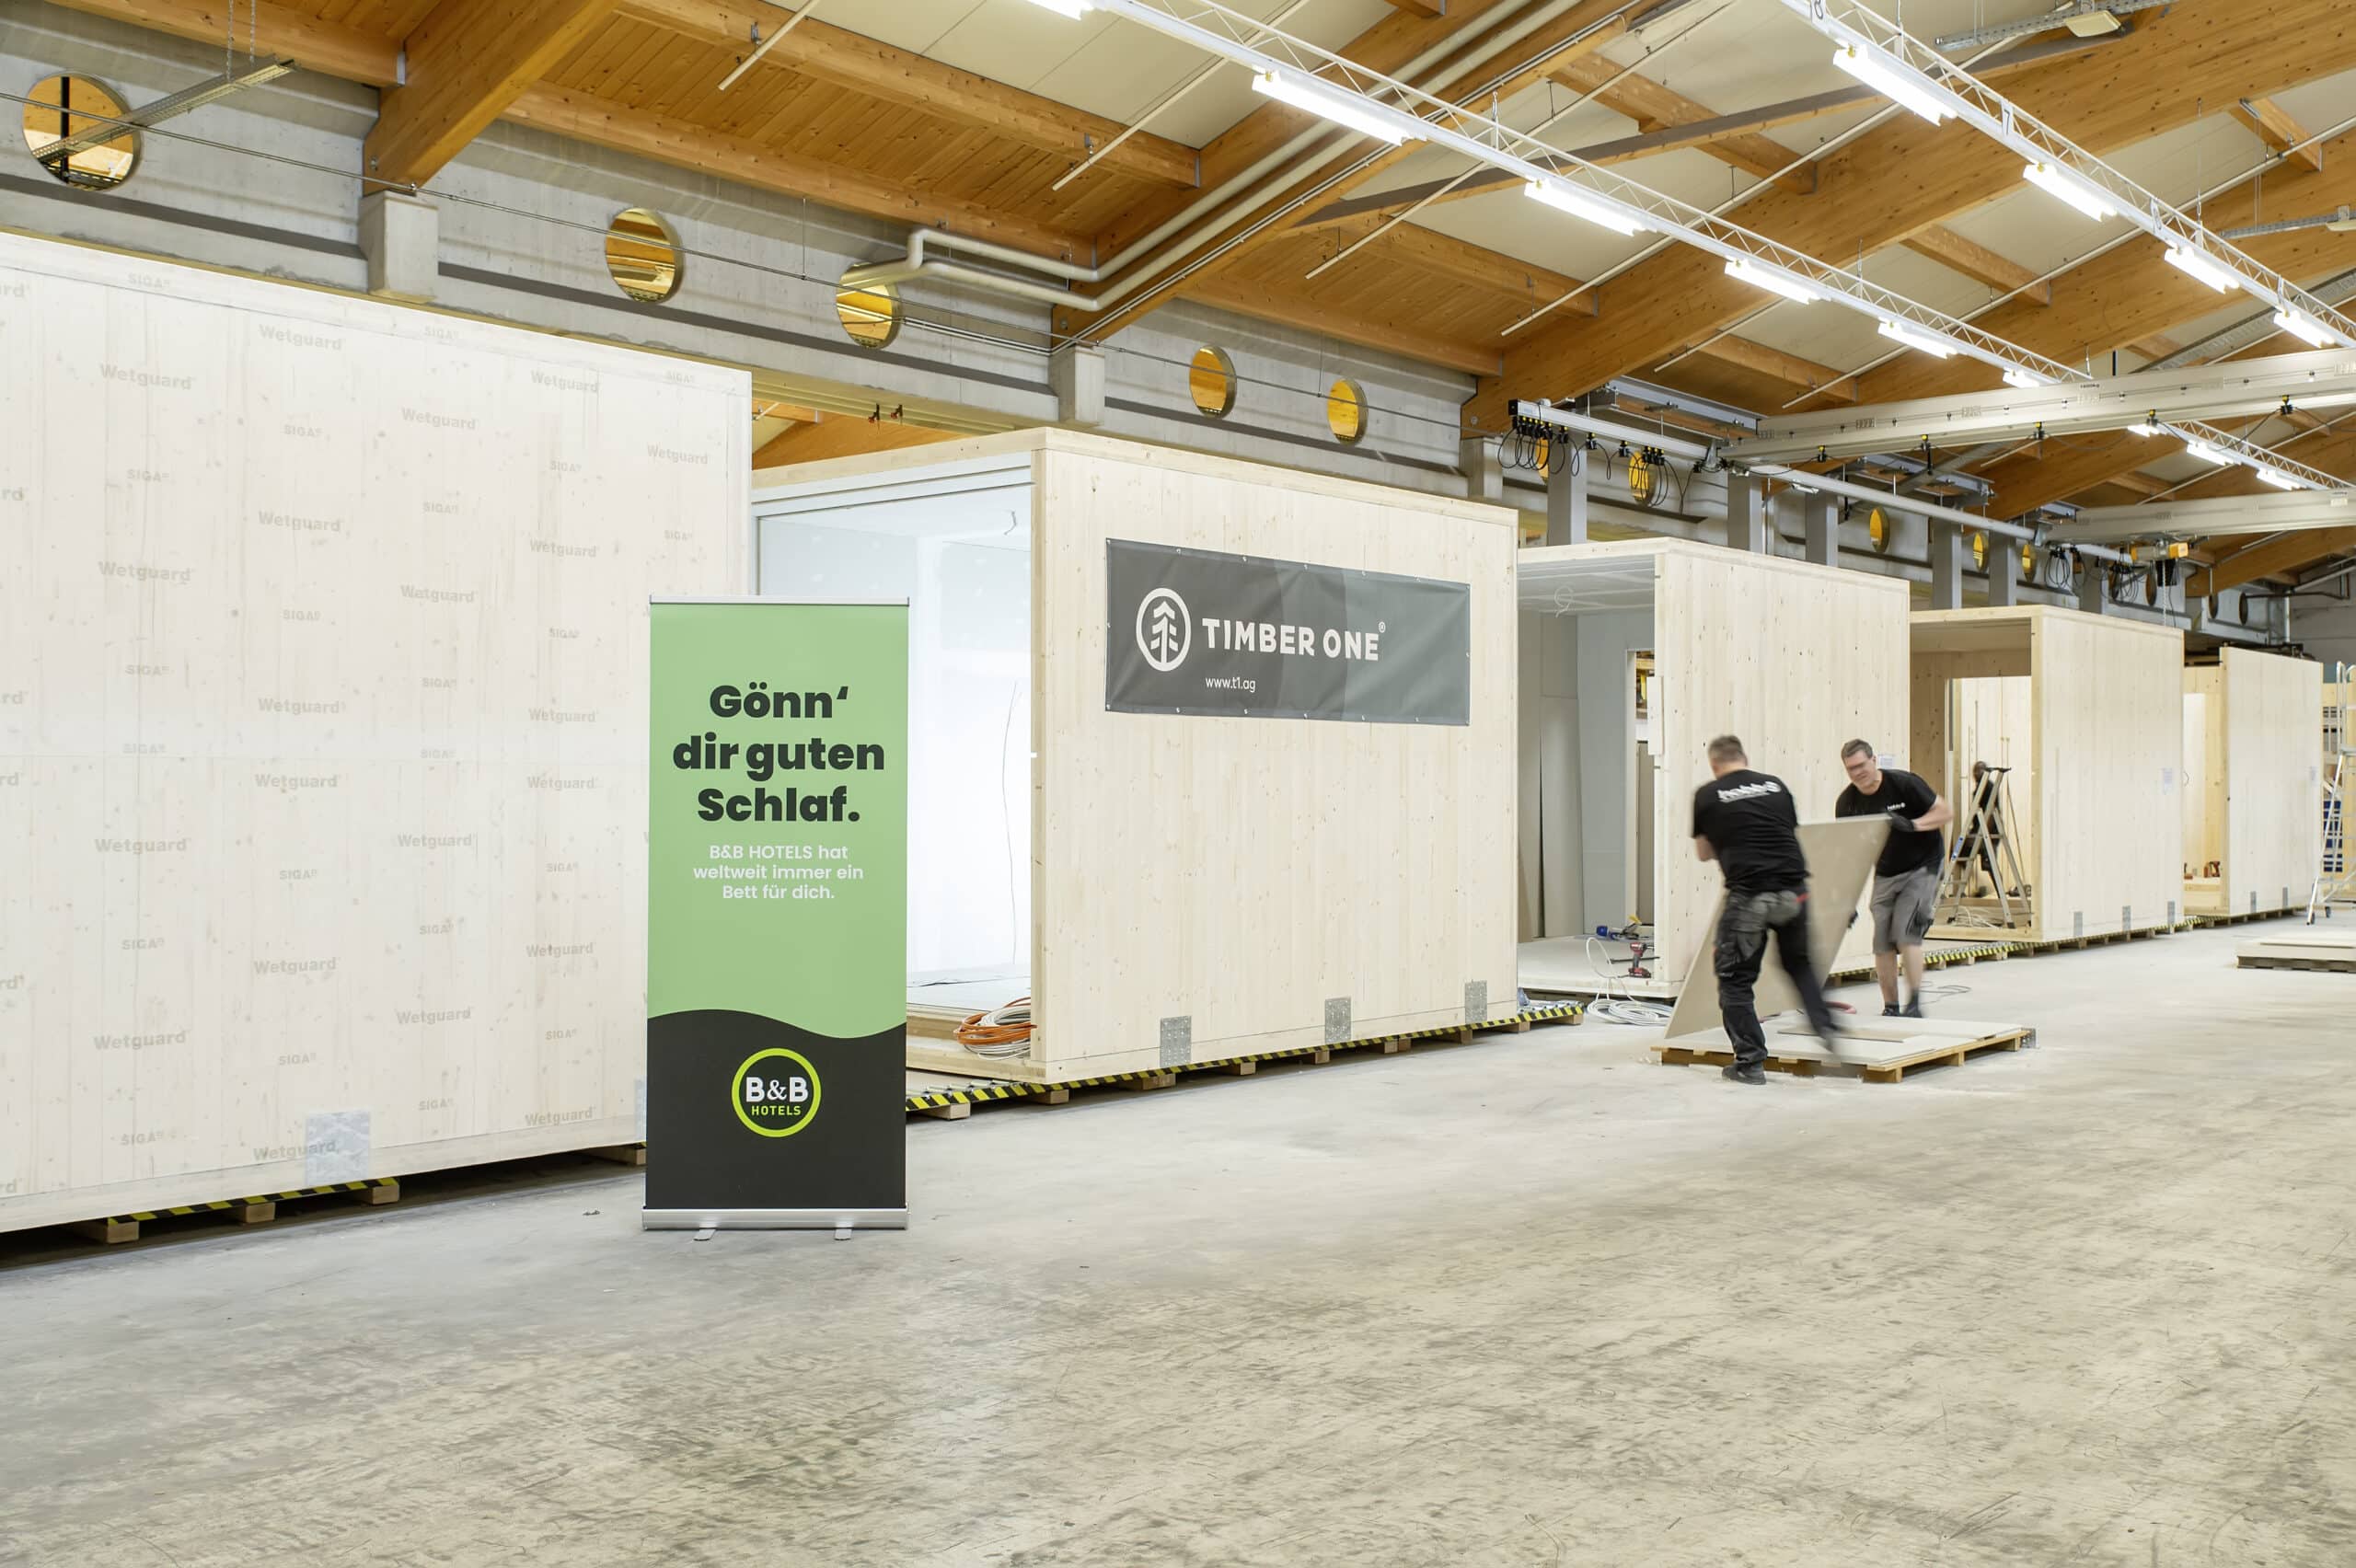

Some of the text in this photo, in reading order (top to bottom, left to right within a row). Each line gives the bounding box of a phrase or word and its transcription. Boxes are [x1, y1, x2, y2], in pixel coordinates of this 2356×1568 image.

[259, 324, 342, 351] Wetguard
[100, 363, 192, 390] Wetguard
[530, 370, 598, 394] Wetguard
[401, 409, 476, 431] Wetguard
[647, 444, 709, 466] Wetguard
[258, 511, 341, 532] Wetguard
[529, 539, 596, 558] Wetguard
[98, 561, 191, 582] Wetguard
[400, 584, 475, 604] Wetguard
[1202, 617, 1315, 656] TIMBER
[1206, 676, 1256, 693] www.t1.ag
[258, 698, 340, 716] Wetguard
[528, 708, 595, 723] Wetguard
[674, 732, 884, 782] dir guten
[254, 774, 338, 790] Wetguard
[526, 777, 595, 790] Wetguard
[698, 786, 860, 822] Schlaf.
[95, 838, 187, 855] Wetguard
[398, 835, 472, 848] Wetguard
[710, 846, 848, 859] B&B HOTELS hat
[694, 865, 863, 879] weltweit immer ein
[723, 885, 835, 899] Bett für dich.
[526, 942, 594, 958] Wetguard
[254, 957, 336, 975] Wetguard
[397, 1008, 471, 1025] Wetguard
[94, 1031, 185, 1051] Wetguard
[745, 1077, 808, 1102] B&B
[525, 1106, 593, 1126] Wetguard
[751, 1106, 801, 1115] HOTELS
[254, 1141, 336, 1161] Wetguard
